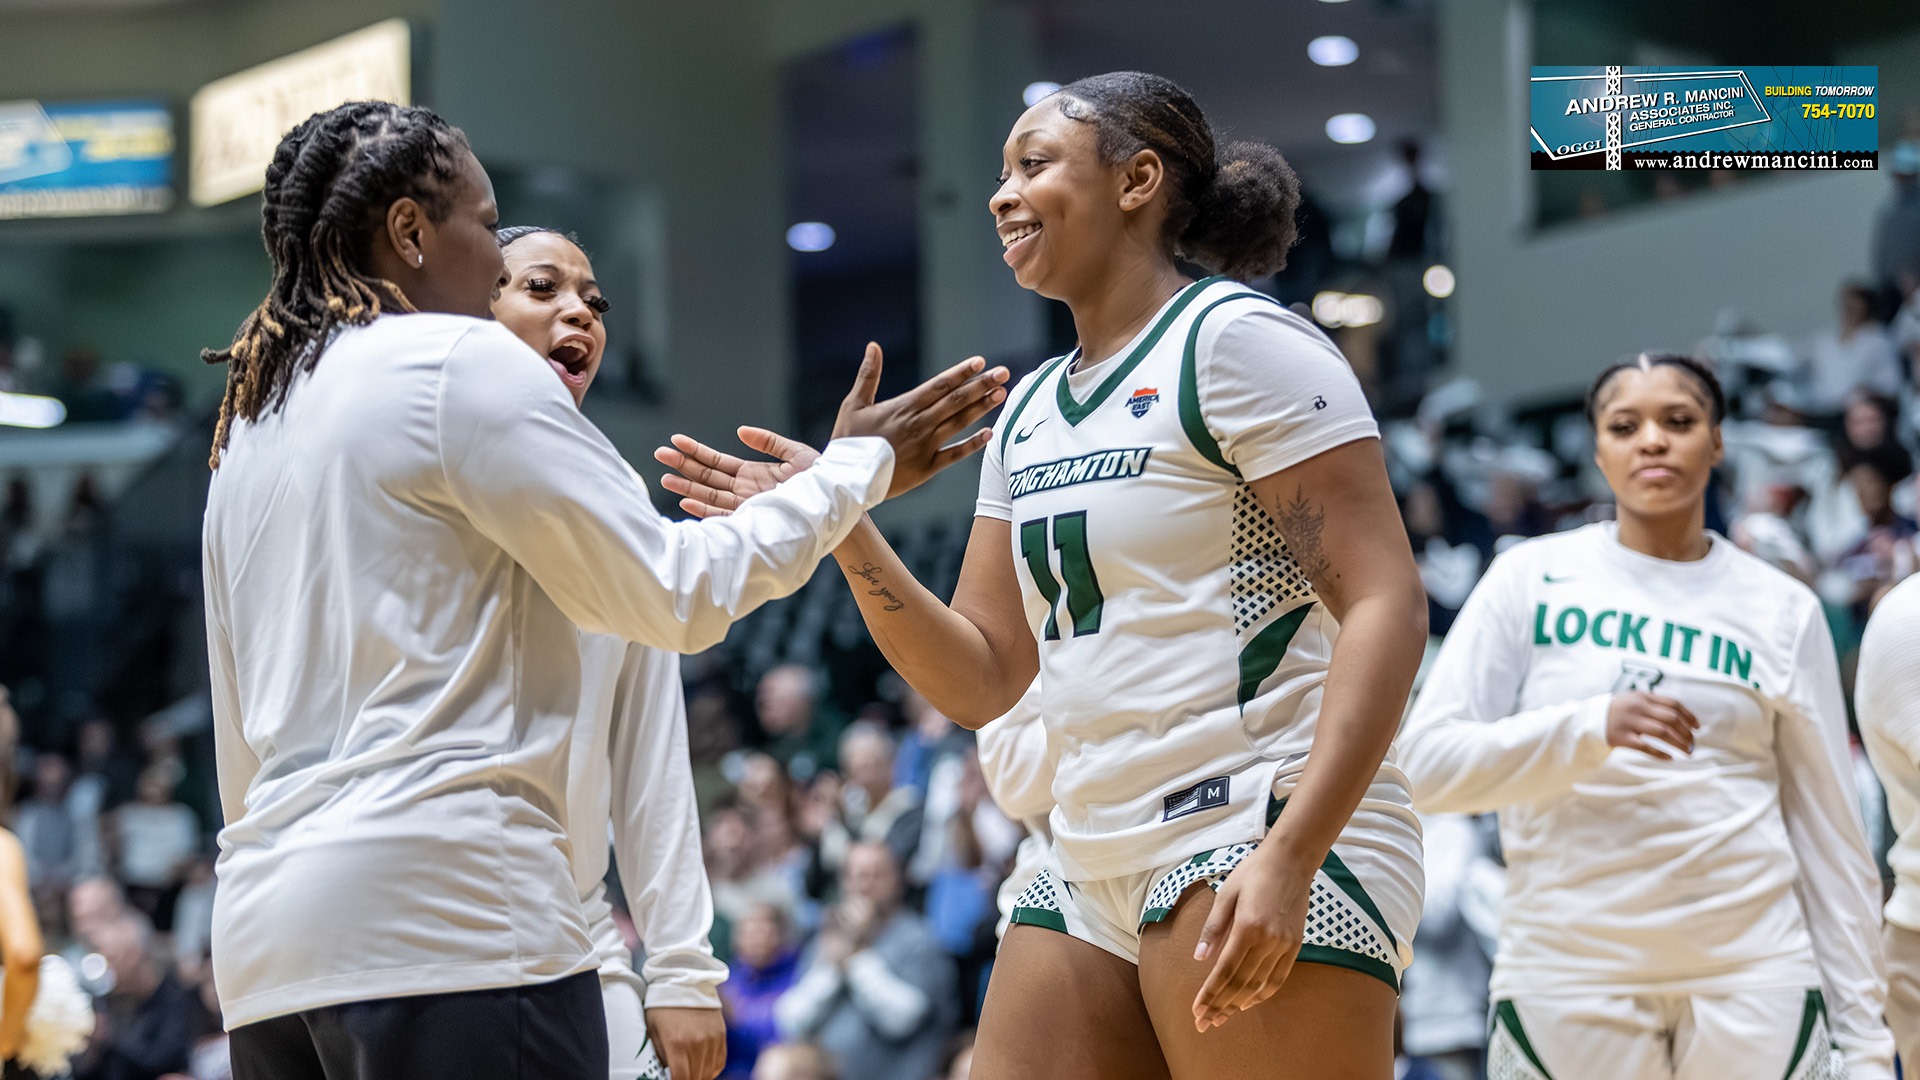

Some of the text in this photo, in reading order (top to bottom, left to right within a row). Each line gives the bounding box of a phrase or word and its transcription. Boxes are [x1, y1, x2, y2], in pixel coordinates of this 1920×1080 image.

[1125, 394, 1159, 407] AMERICA
[1132, 402, 1150, 410] EAST
[847, 562, 882, 585] Love
[1020, 510, 1104, 641] 11
[1534, 603, 1649, 653] LOCK
[1660, 622, 1701, 663] IT
[1709, 634, 1760, 689] IN.
[1207, 786, 1220, 799] M
